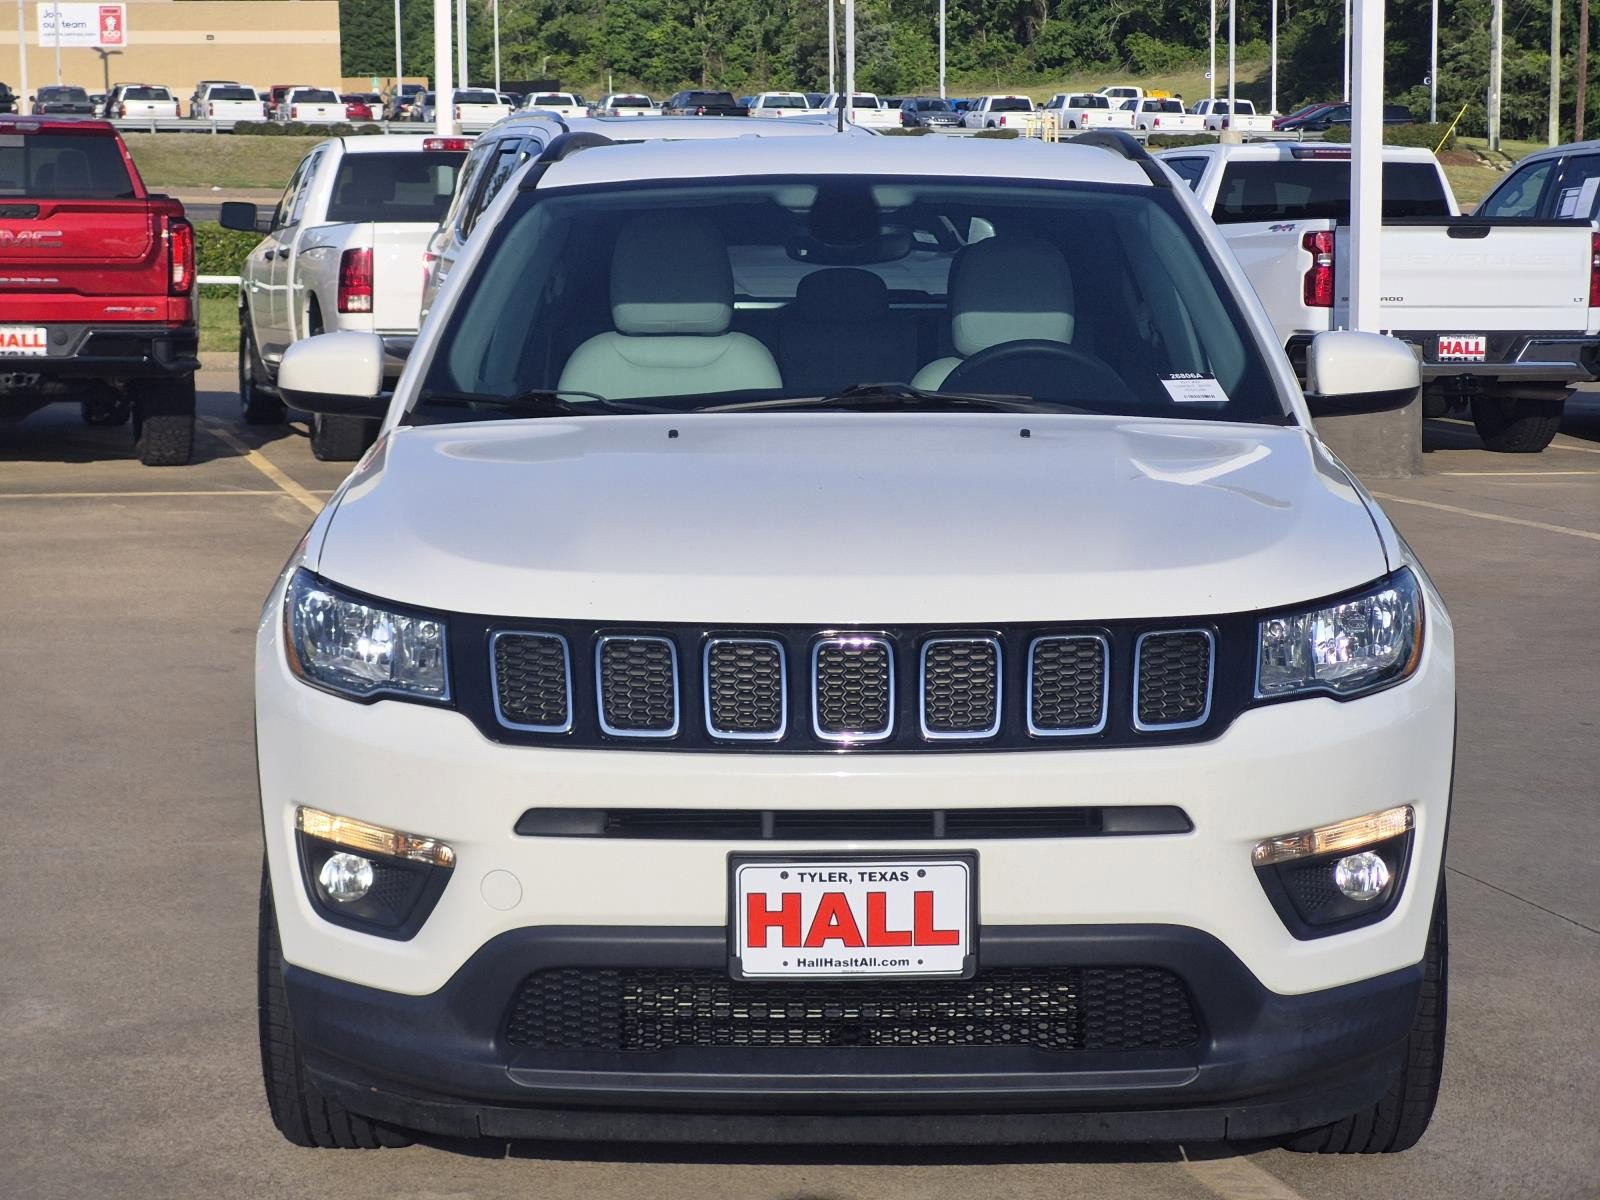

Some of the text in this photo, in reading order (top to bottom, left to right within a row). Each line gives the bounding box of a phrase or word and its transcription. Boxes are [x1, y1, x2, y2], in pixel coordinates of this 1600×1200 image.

[1440, 341, 1484, 354] HALL
[798, 871, 909, 884] TYLER, TEXAS
[747, 891, 960, 948] HALL
[797, 957, 910, 967] HallHasItAll.com
